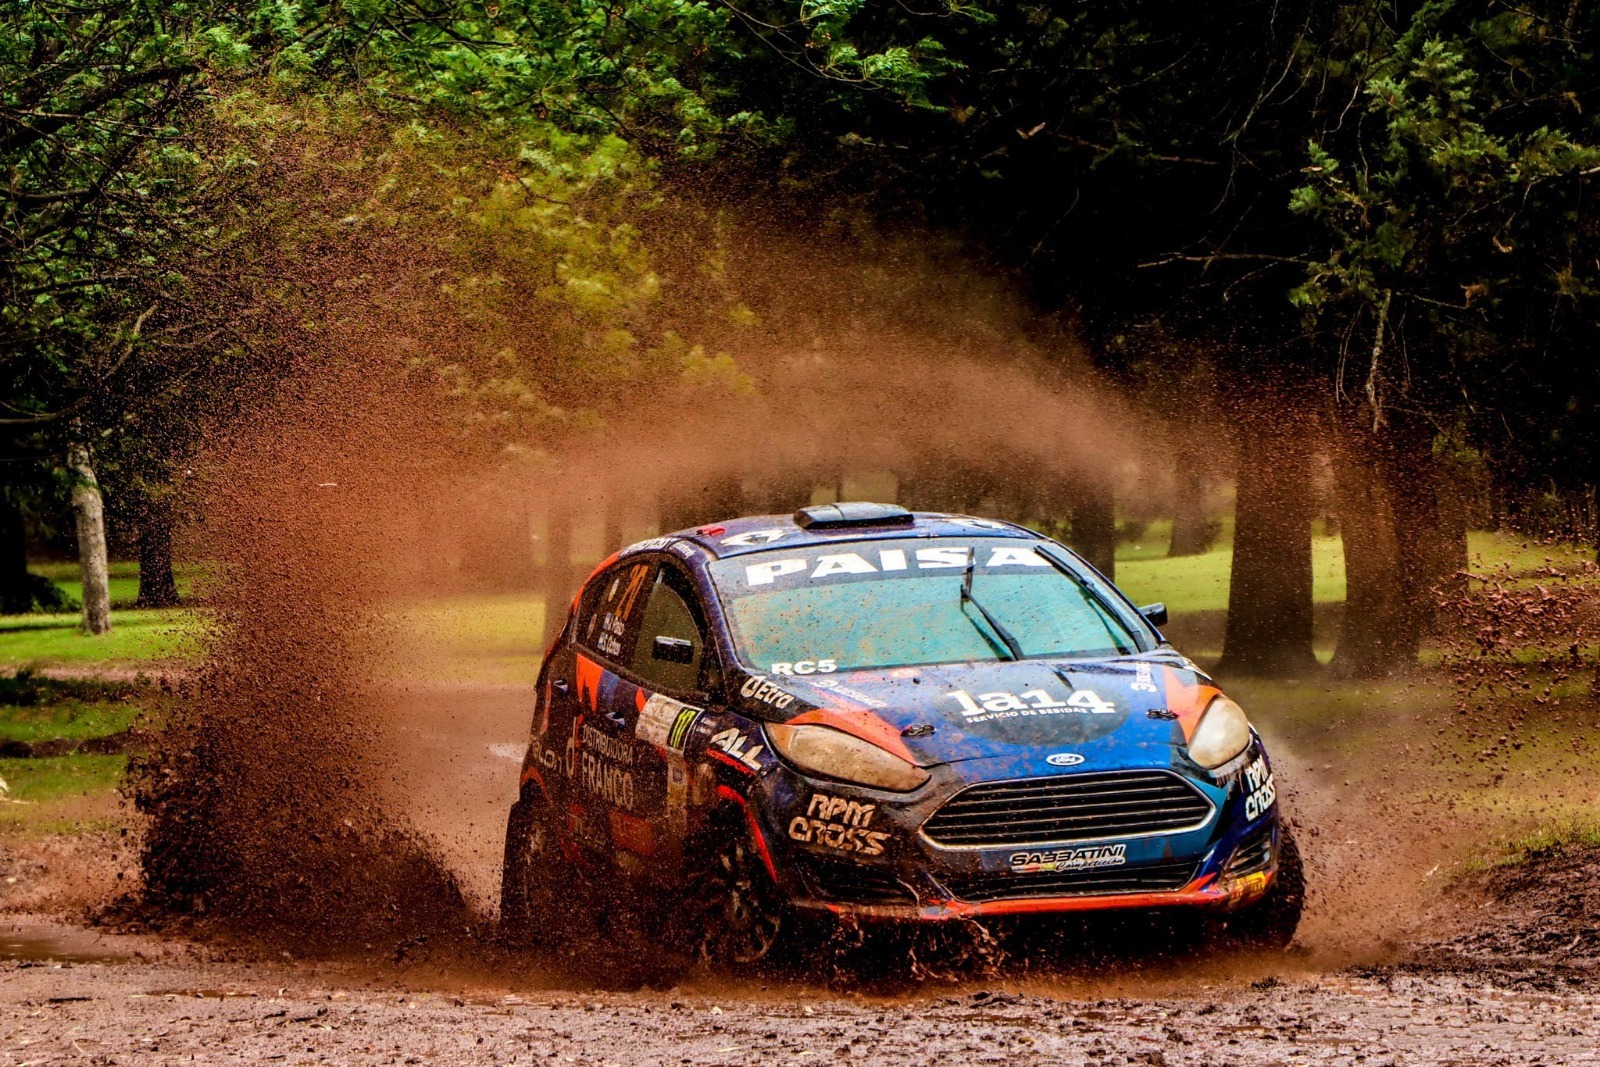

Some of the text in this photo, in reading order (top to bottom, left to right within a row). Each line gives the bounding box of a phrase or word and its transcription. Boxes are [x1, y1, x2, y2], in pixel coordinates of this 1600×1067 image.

[745, 546, 1053, 587] PAISA
[771, 659, 838, 676] RC5
[966, 706, 1089, 724] SERVICIO DE BEBIDAS
[710, 727, 765, 771] ALL
[806, 793, 877, 828] RPM
[788, 816, 892, 856] CROSS
